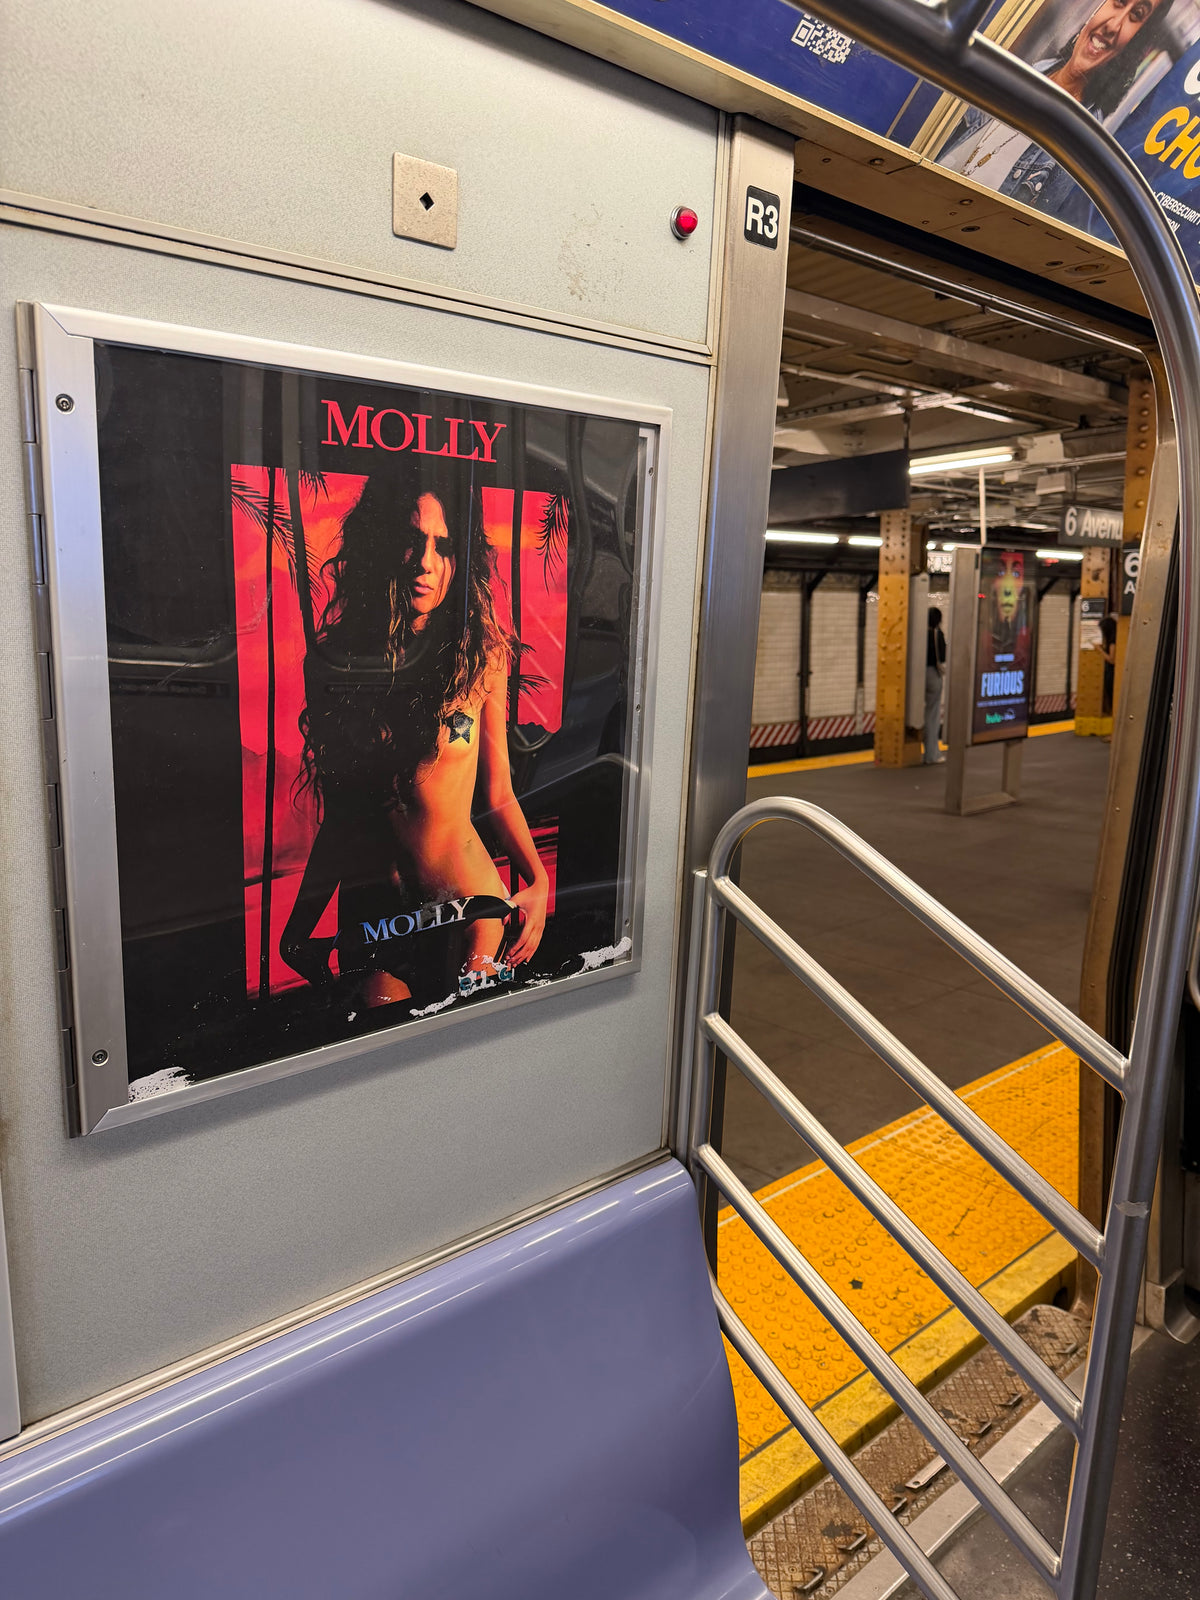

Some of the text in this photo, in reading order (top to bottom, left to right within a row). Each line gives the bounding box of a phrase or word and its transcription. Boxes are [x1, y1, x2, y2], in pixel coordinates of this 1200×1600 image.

[746, 196, 779, 239] R3
[321, 399, 507, 463] MOLLY
[1065, 506, 1077, 537] 6
[1124, 552, 1141, 578] 6
[981, 669, 1025, 698] FURIOUS
[360, 896, 475, 944] MOLLY
